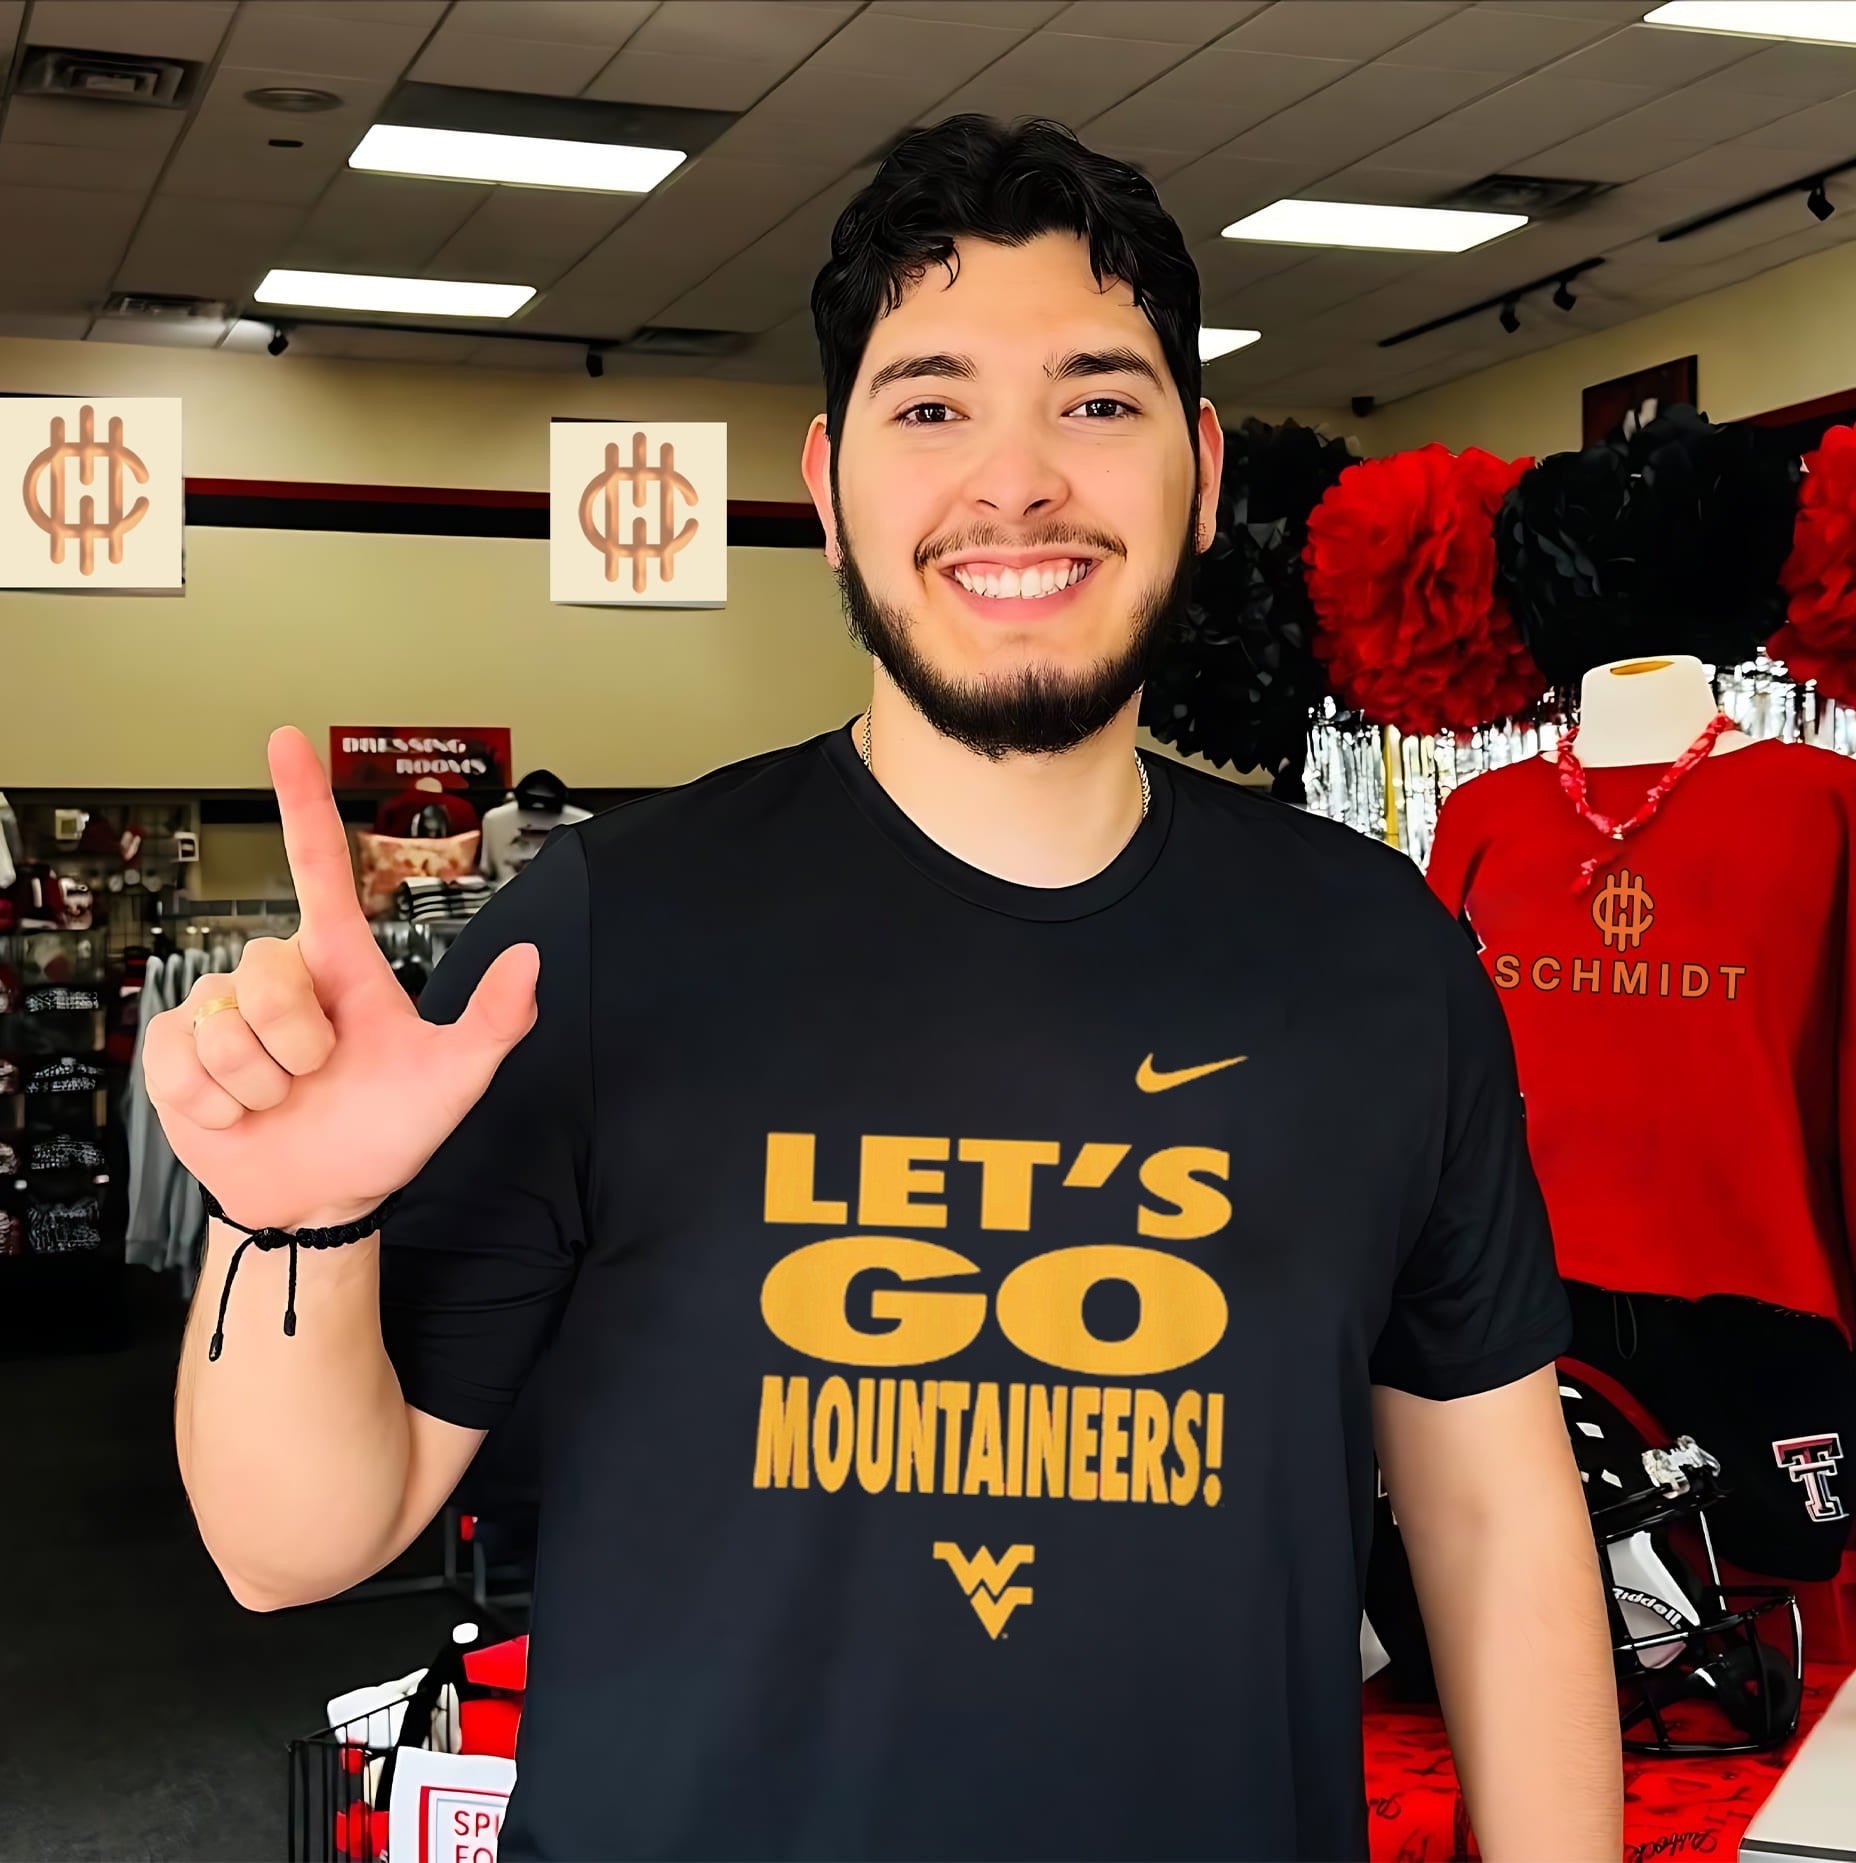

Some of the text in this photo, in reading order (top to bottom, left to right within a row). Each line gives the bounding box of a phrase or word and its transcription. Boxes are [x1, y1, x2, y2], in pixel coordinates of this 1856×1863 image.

[341, 737, 467, 754] DRESSING
[395, 758, 488, 775] ROOMS
[1494, 953, 1747, 1000] SCHMIDT
[764, 1132, 1232, 1240] LET'S
[760, 1235, 1228, 1376] GO
[753, 1375, 1225, 1507] MOUNTAINEERS!
